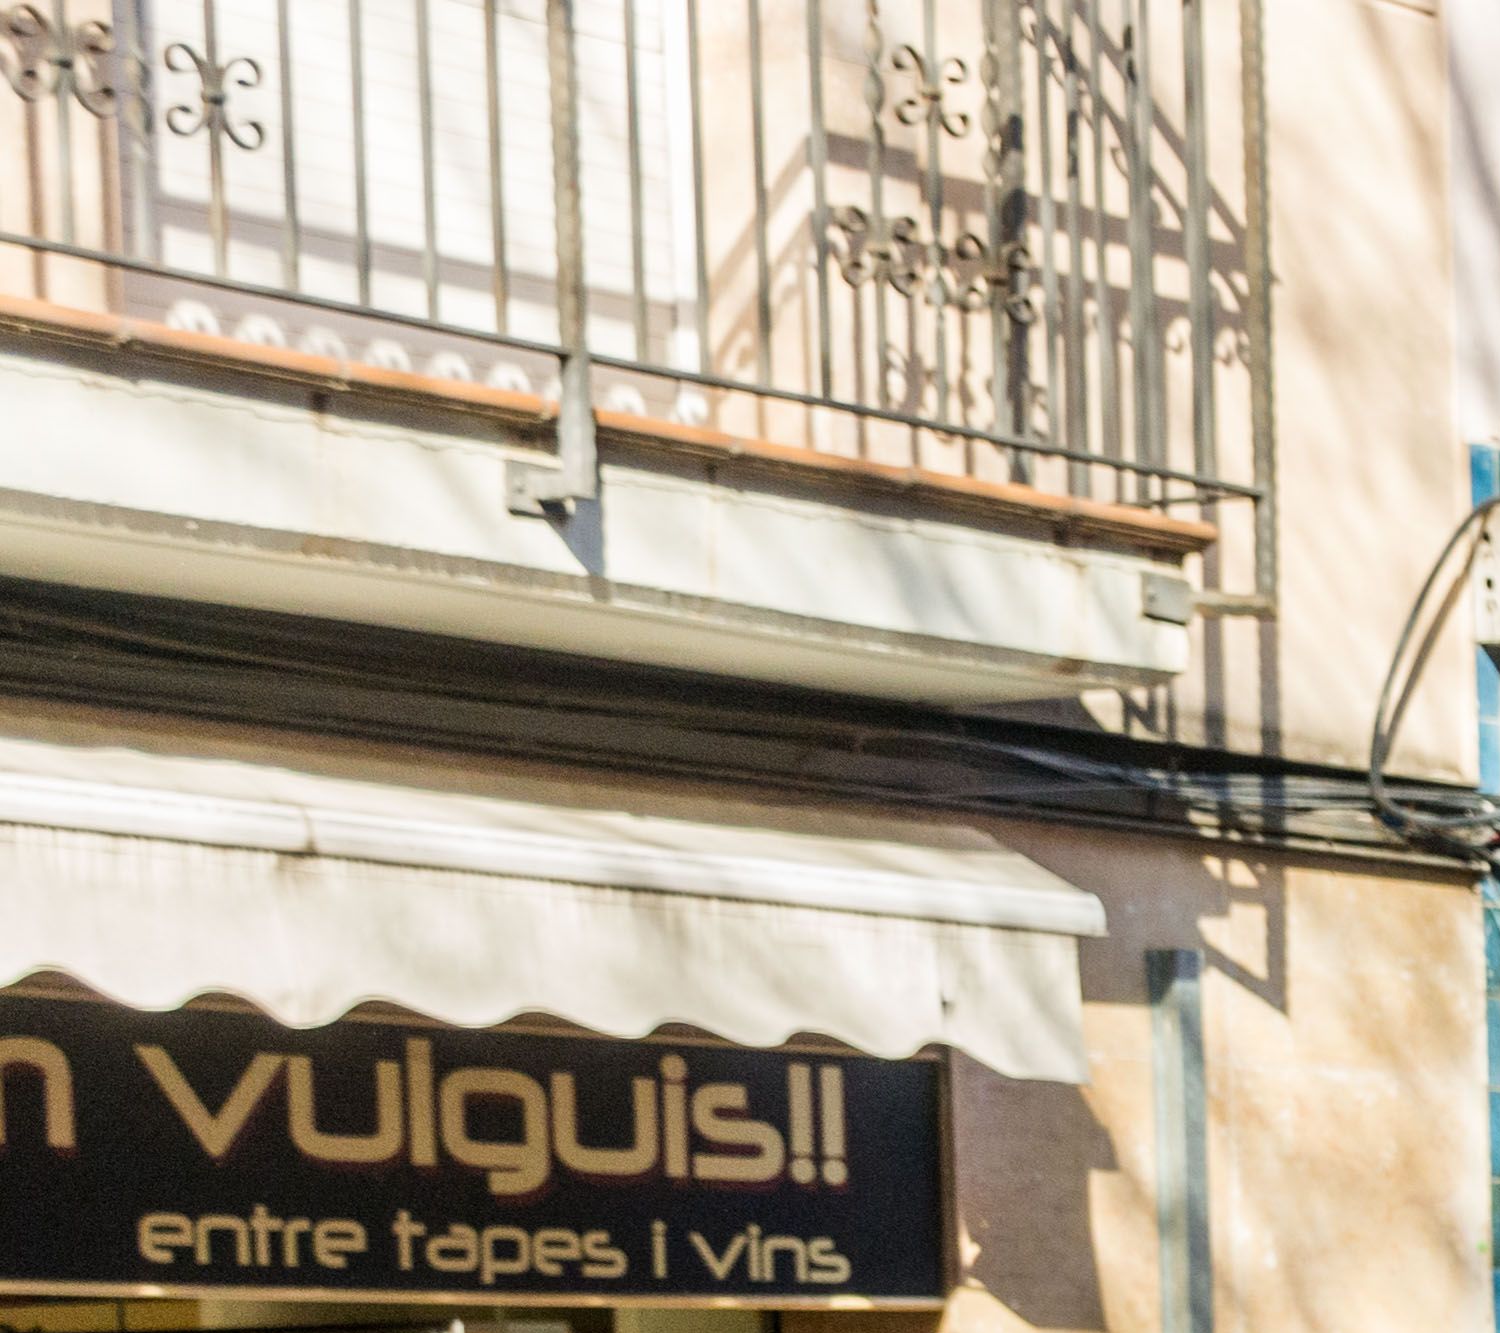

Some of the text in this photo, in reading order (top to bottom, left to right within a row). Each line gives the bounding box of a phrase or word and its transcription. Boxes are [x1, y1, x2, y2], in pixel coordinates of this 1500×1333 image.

[133, 1037, 848, 1196] vulguis!!
[138, 1203, 850, 1285] entre tapes i vins
